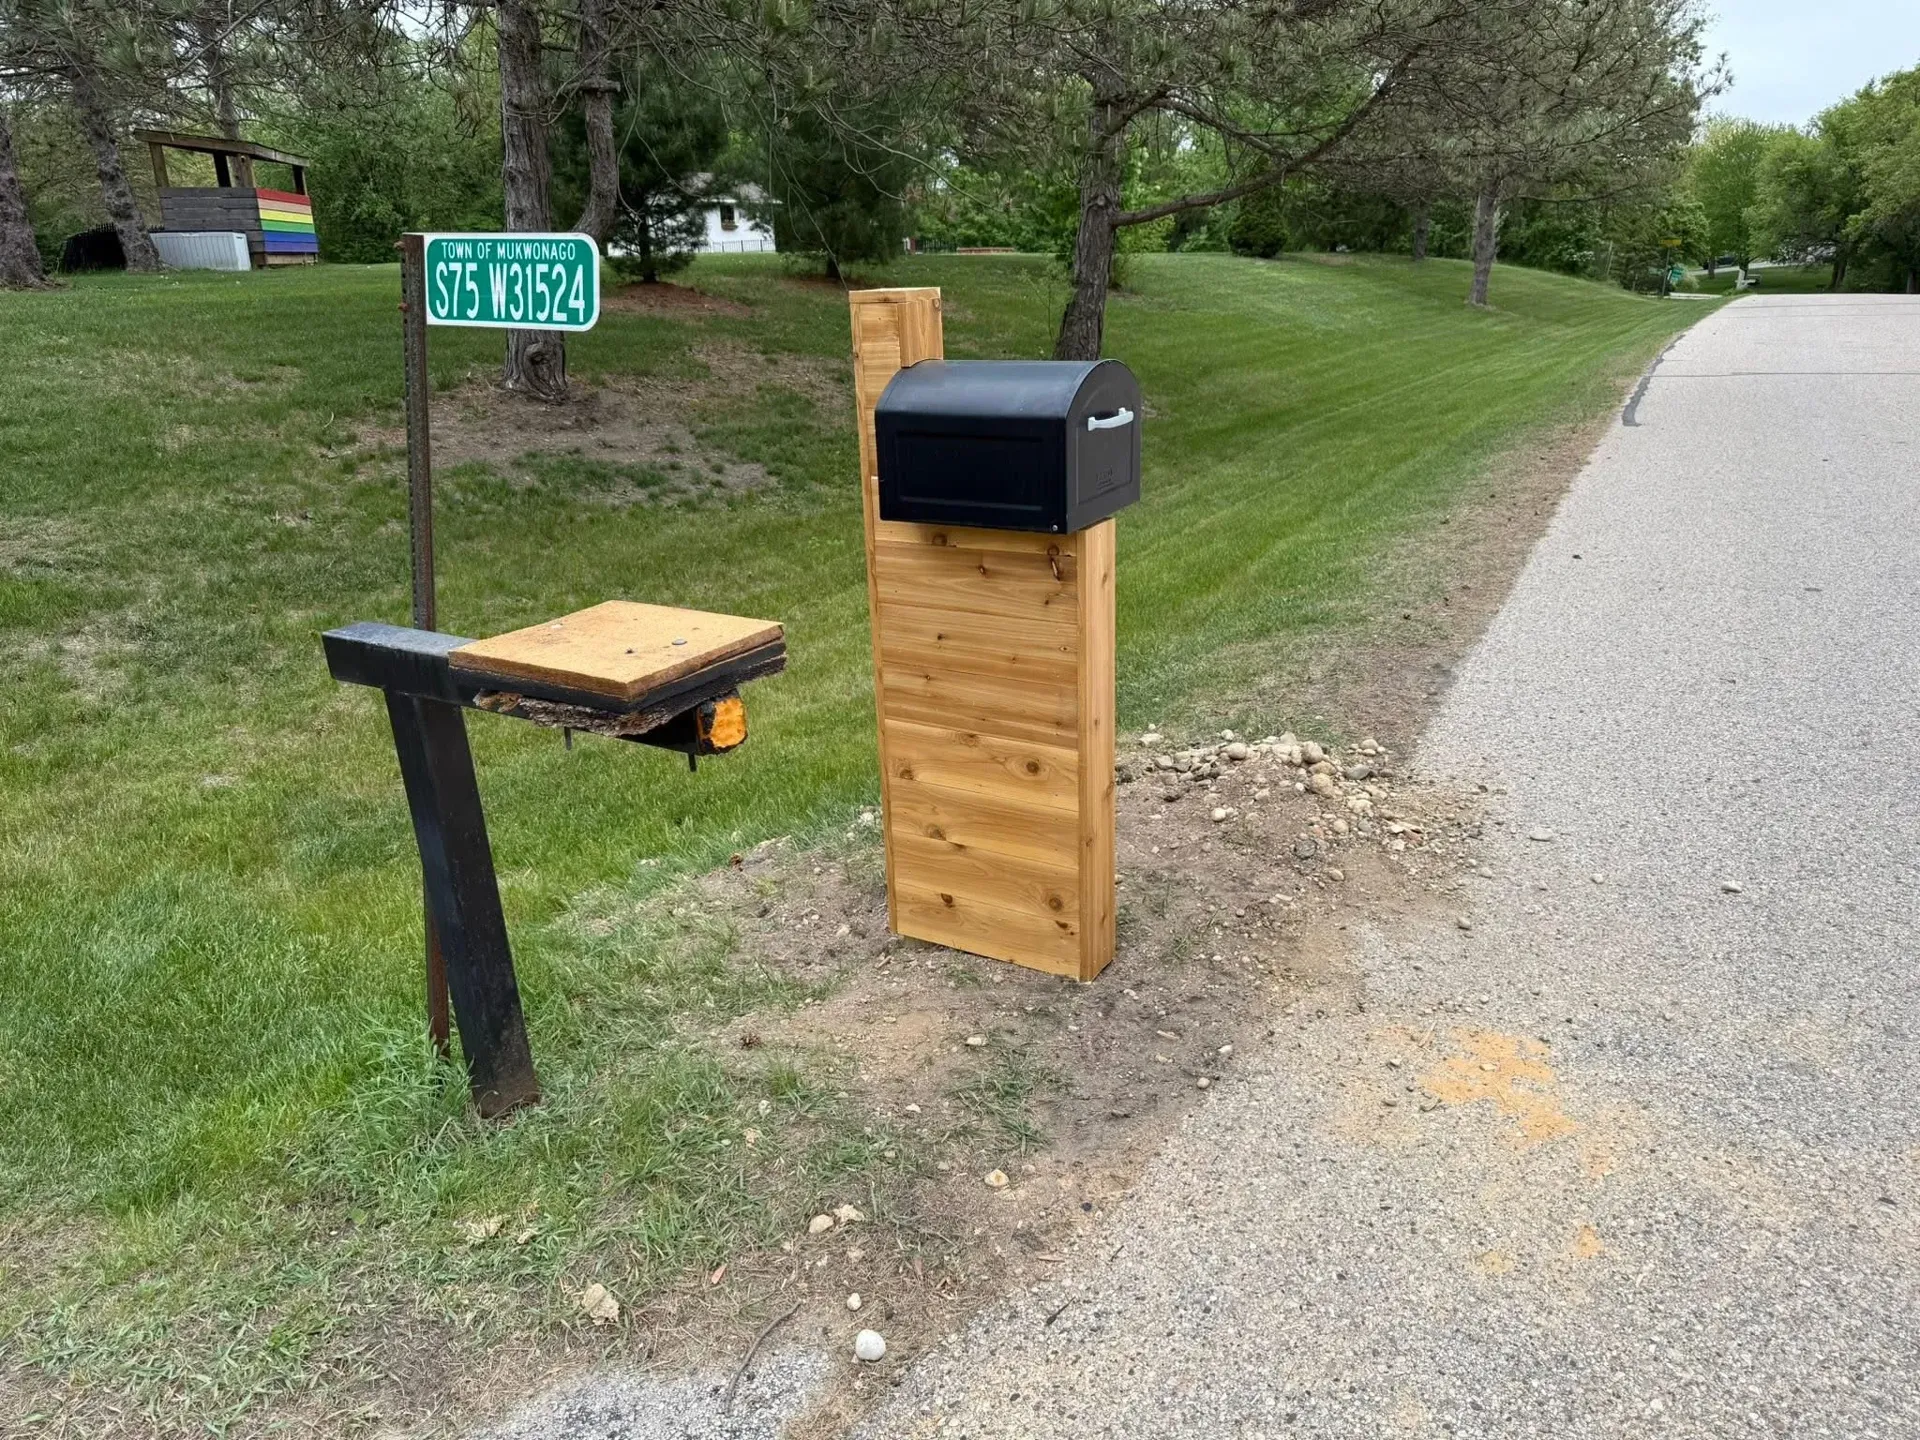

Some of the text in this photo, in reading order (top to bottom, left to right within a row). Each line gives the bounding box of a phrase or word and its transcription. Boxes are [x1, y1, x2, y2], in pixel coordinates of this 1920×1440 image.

[441, 242, 576, 261] TOWN OF MUKWONAGO
[435, 261, 585, 322] S75 W31524
